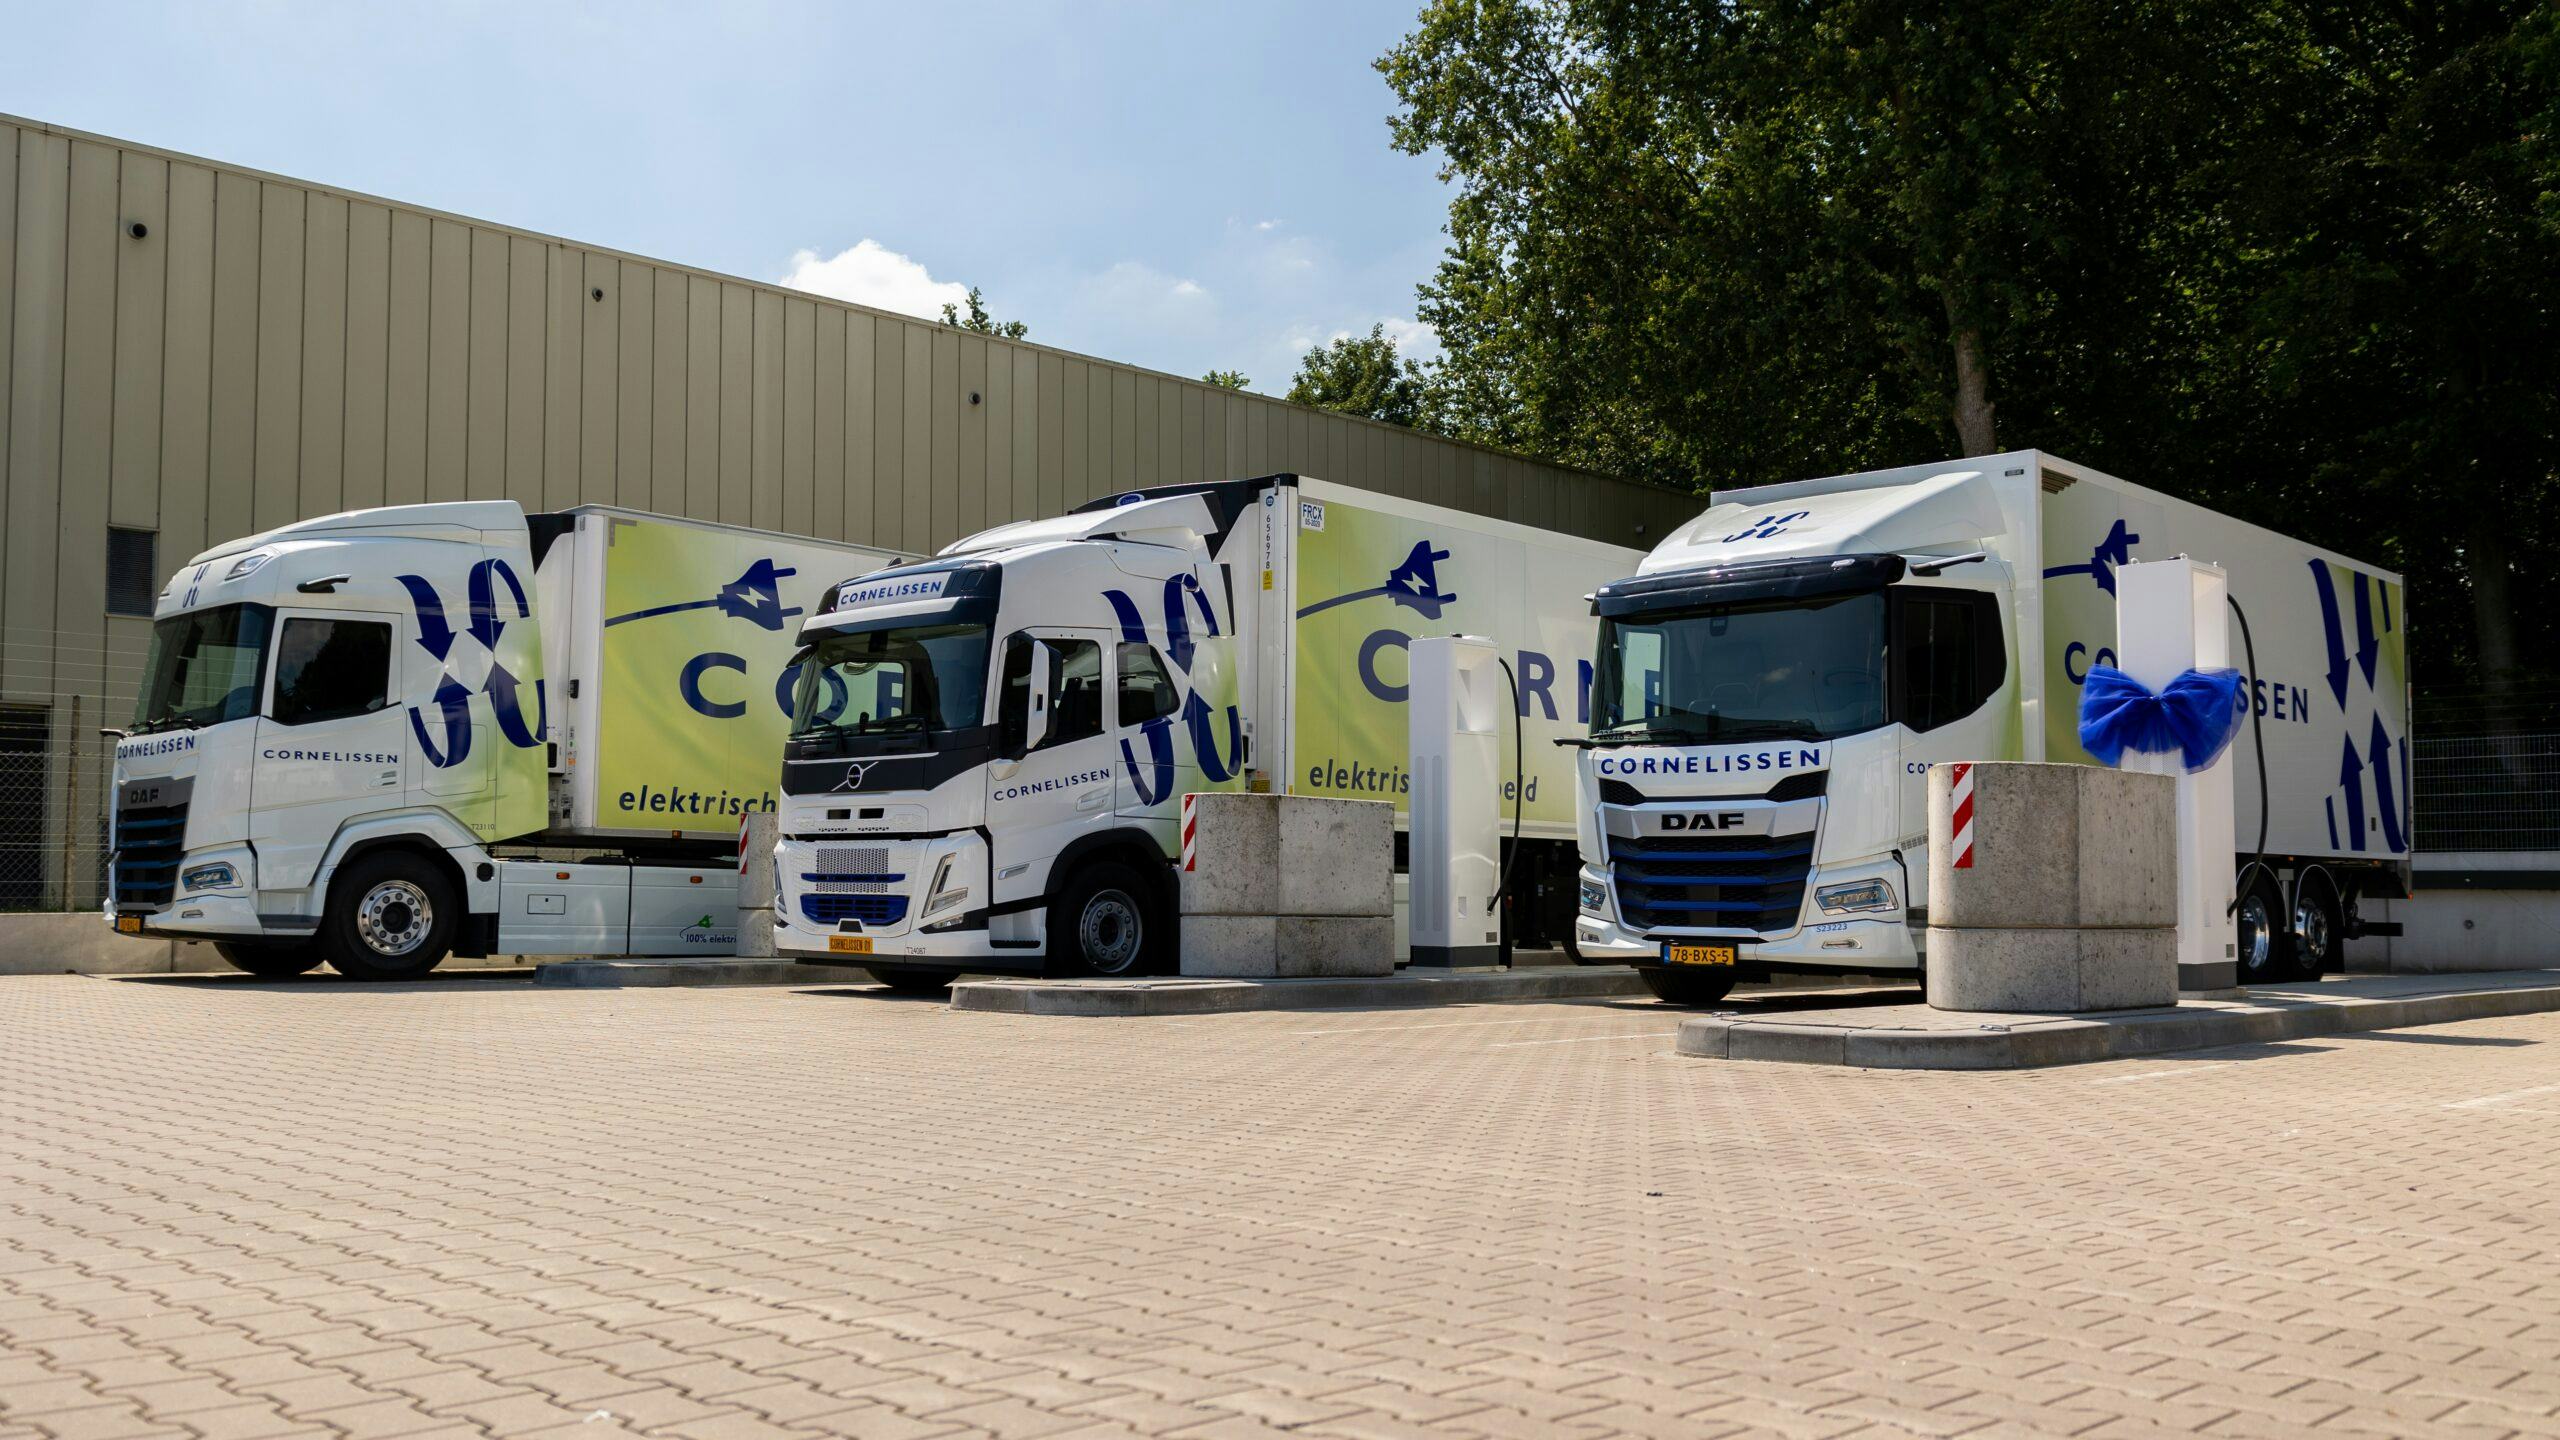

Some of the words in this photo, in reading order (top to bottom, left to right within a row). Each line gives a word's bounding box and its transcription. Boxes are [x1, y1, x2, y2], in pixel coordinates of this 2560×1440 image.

[1302, 503, 1323, 521] FRCX
[840, 581, 942, 605] CORNELISSEN
[117, 735, 195, 759] CORNELISSEN
[263, 749, 398, 763] CORNELISSEN
[1600, 748, 1820, 775] CORNELISSEN
[993, 768, 1110, 801] CORNELISSEN
[1309, 758, 1410, 794] elektris
[130, 788, 159, 804] DAF
[618, 784, 777, 816] elektrisch
[1660, 811, 1745, 831] DAF
[1816, 921, 1848, 933] S23223
[686, 933, 707, 944] 100%
[1673, 948, 1729, 963] 78-BXS-5
